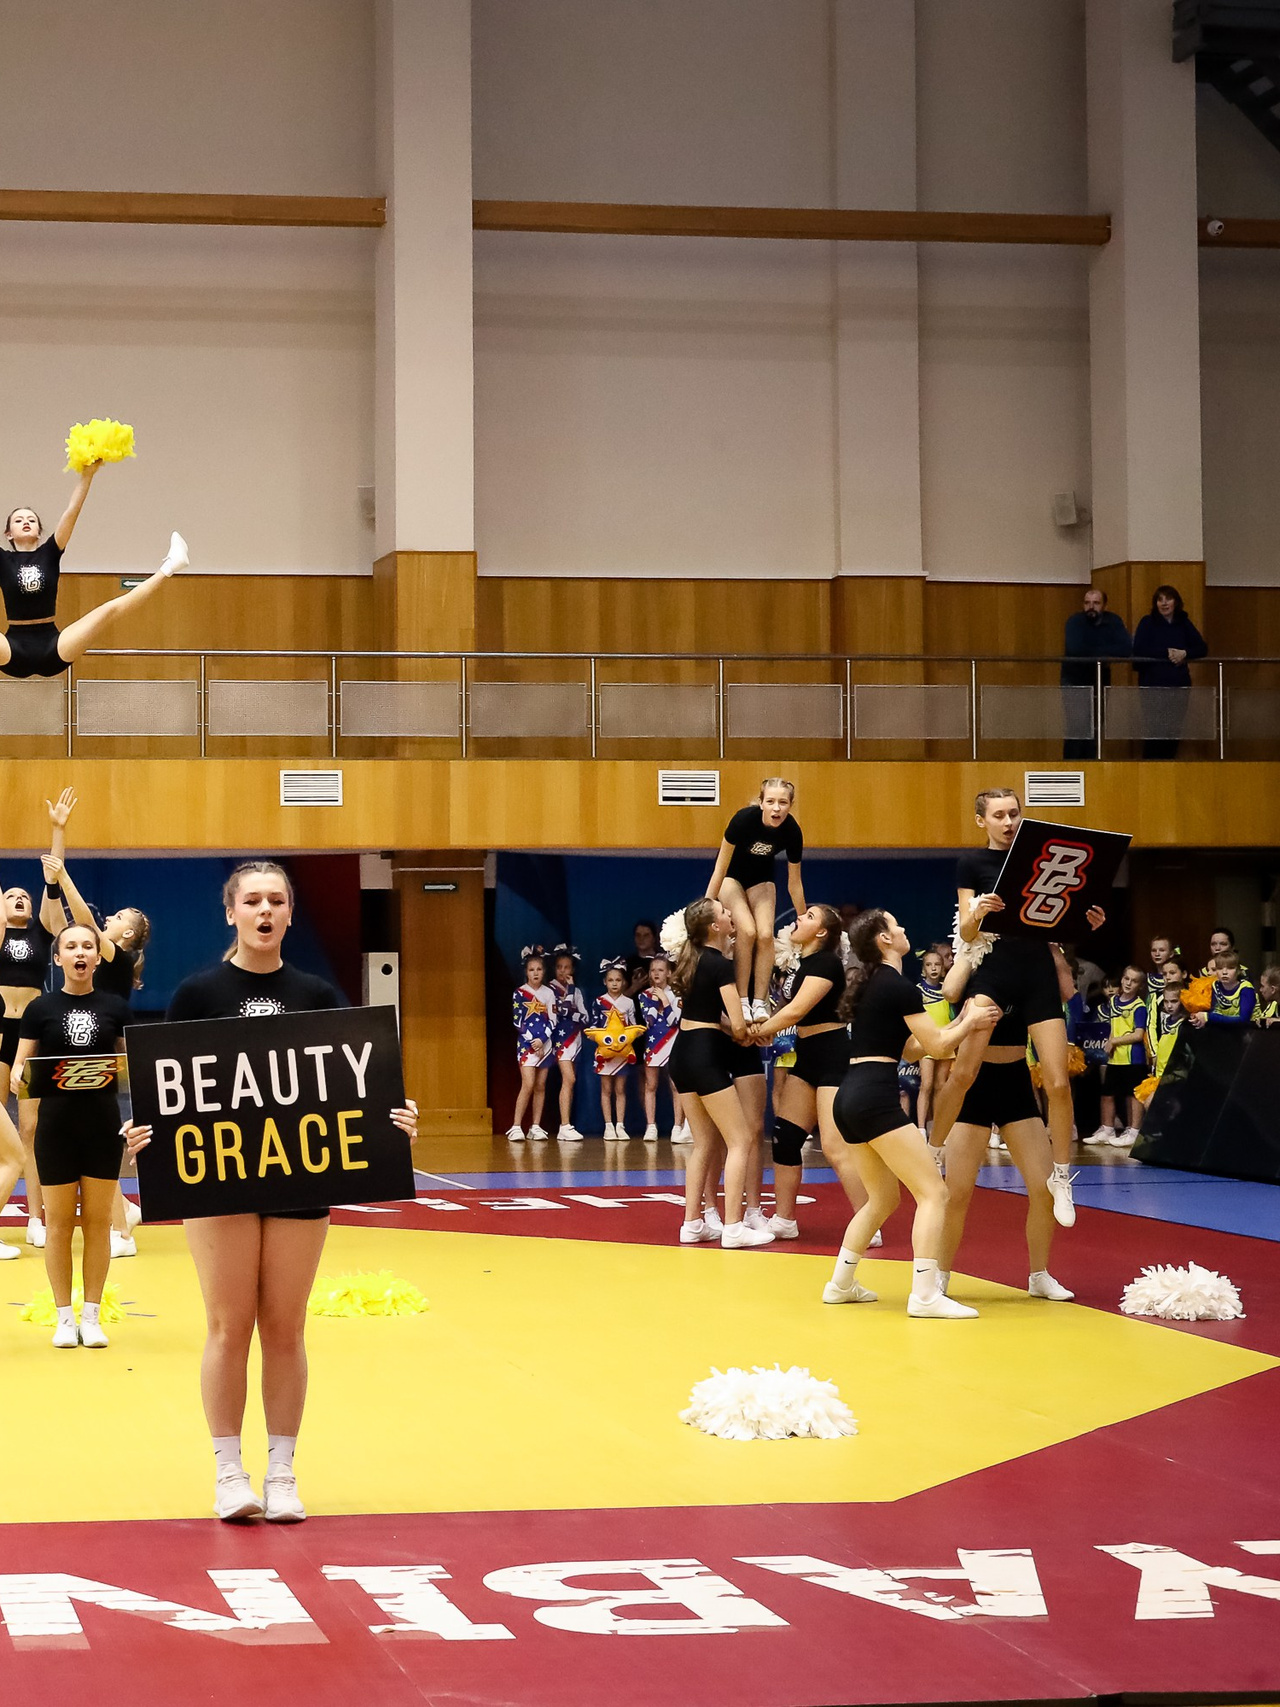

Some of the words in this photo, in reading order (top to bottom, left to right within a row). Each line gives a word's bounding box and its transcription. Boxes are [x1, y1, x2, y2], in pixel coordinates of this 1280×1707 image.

[154, 1041, 373, 1116] BEAUTY
[1083, 1038, 1109, 1050] СКАЙ
[174, 1110, 369, 1185] GRACE
